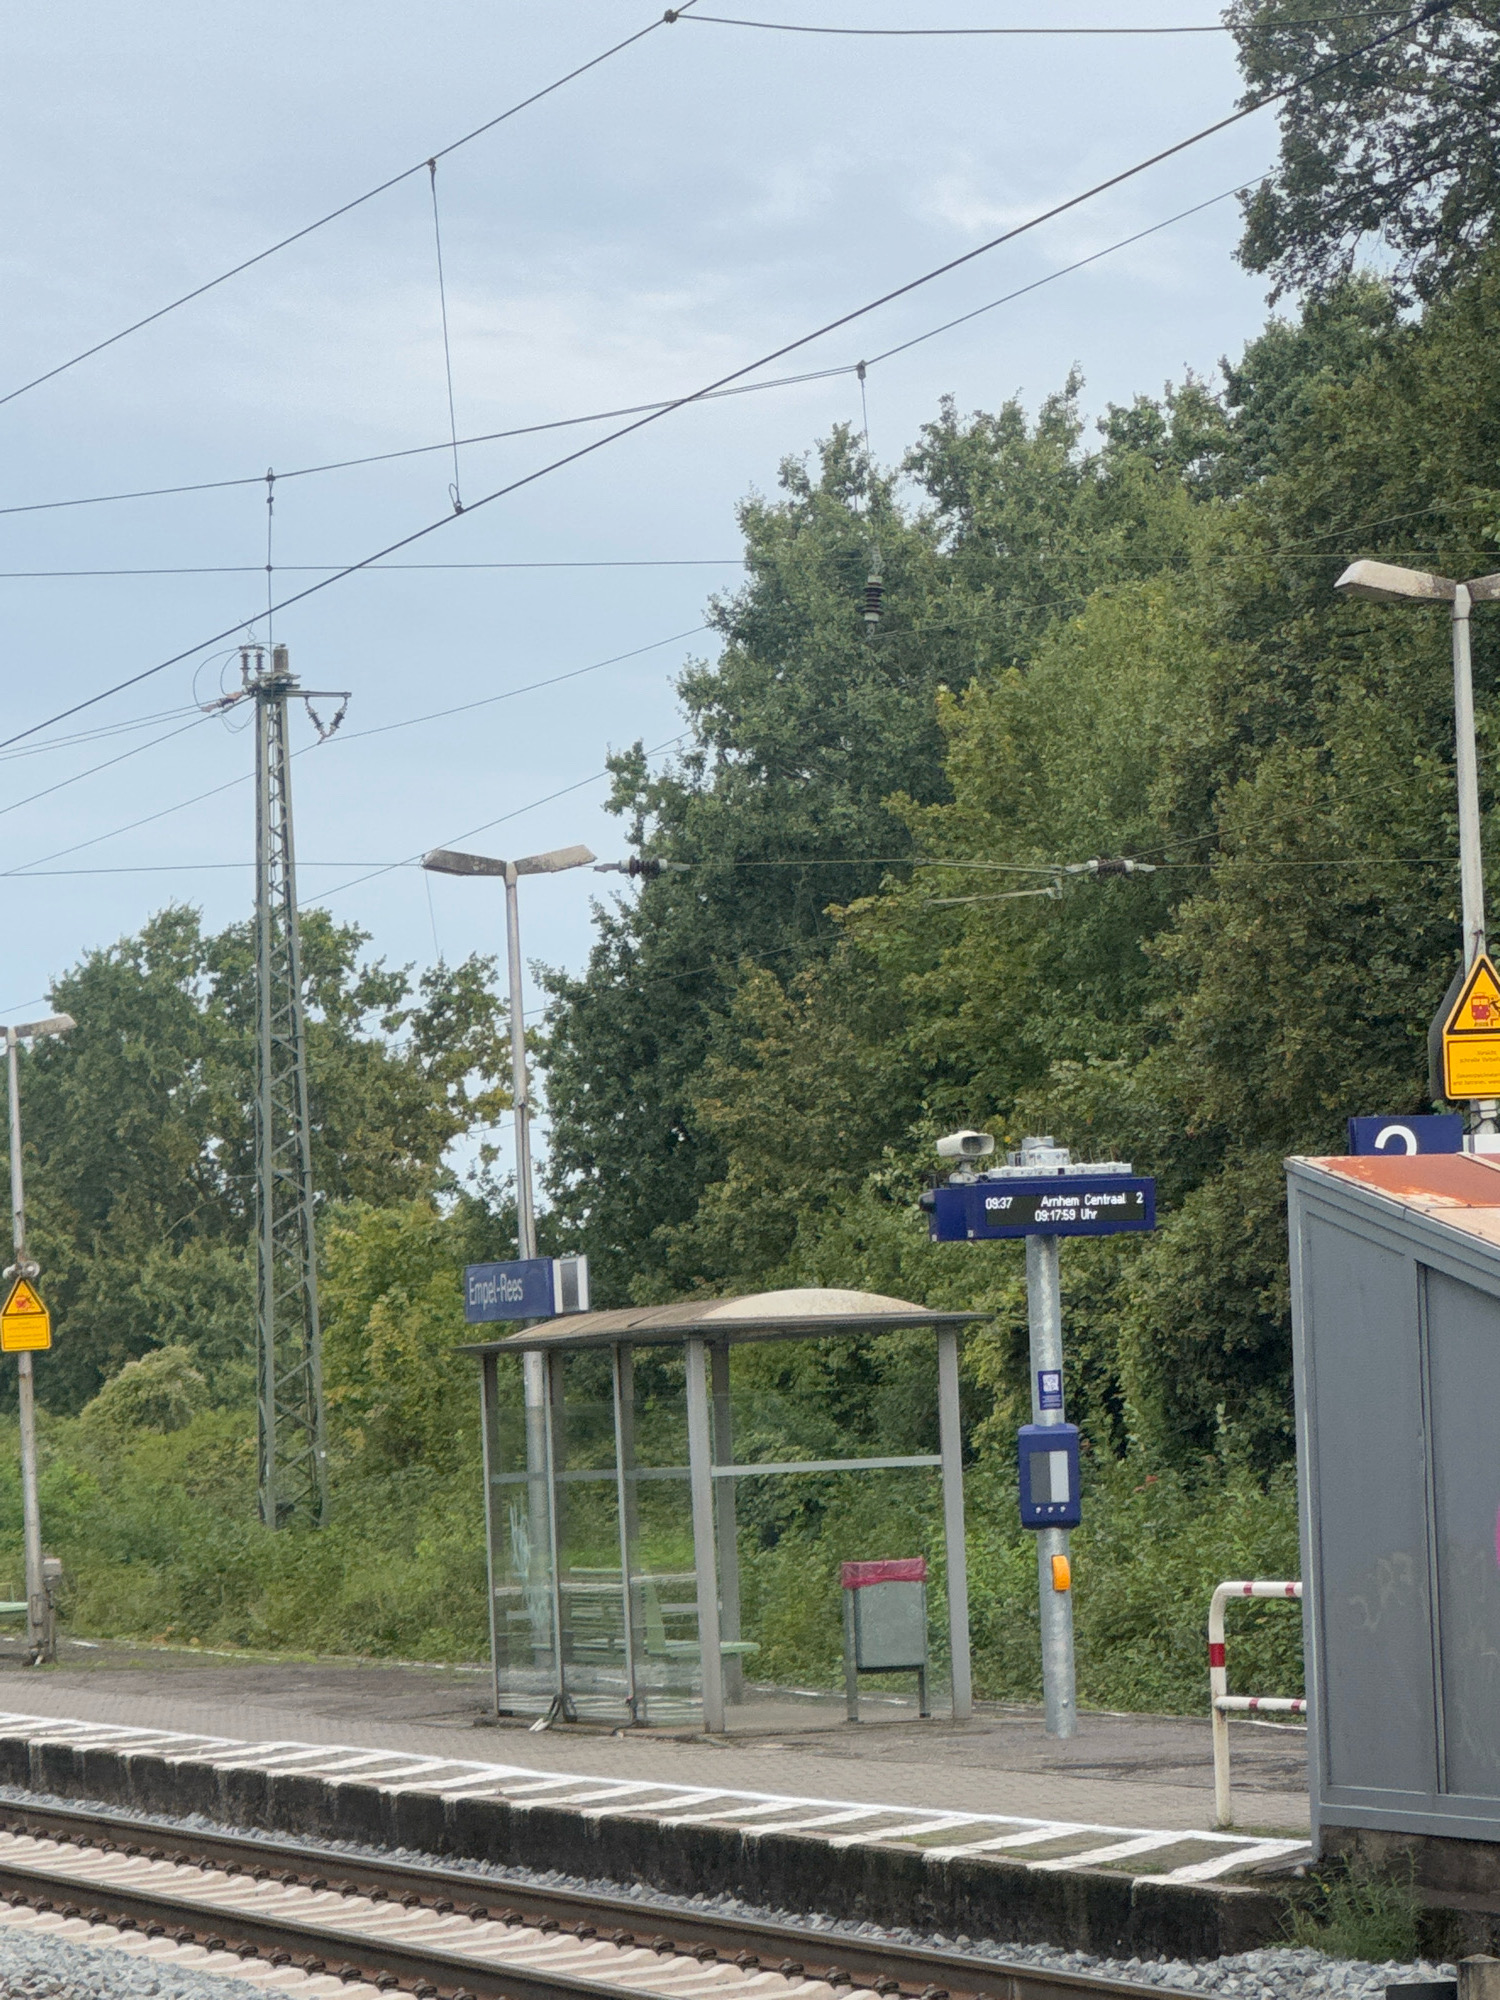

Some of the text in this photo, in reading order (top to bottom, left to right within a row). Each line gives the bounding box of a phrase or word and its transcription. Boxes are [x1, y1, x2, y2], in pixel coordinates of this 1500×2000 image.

[985, 1192, 1143, 1210] 09:37 Arnhem Centraal 2
[1035, 1208, 1098, 1222] 09:17:59 Uhr
[469, 1273, 524, 1311] Empel-Rees
